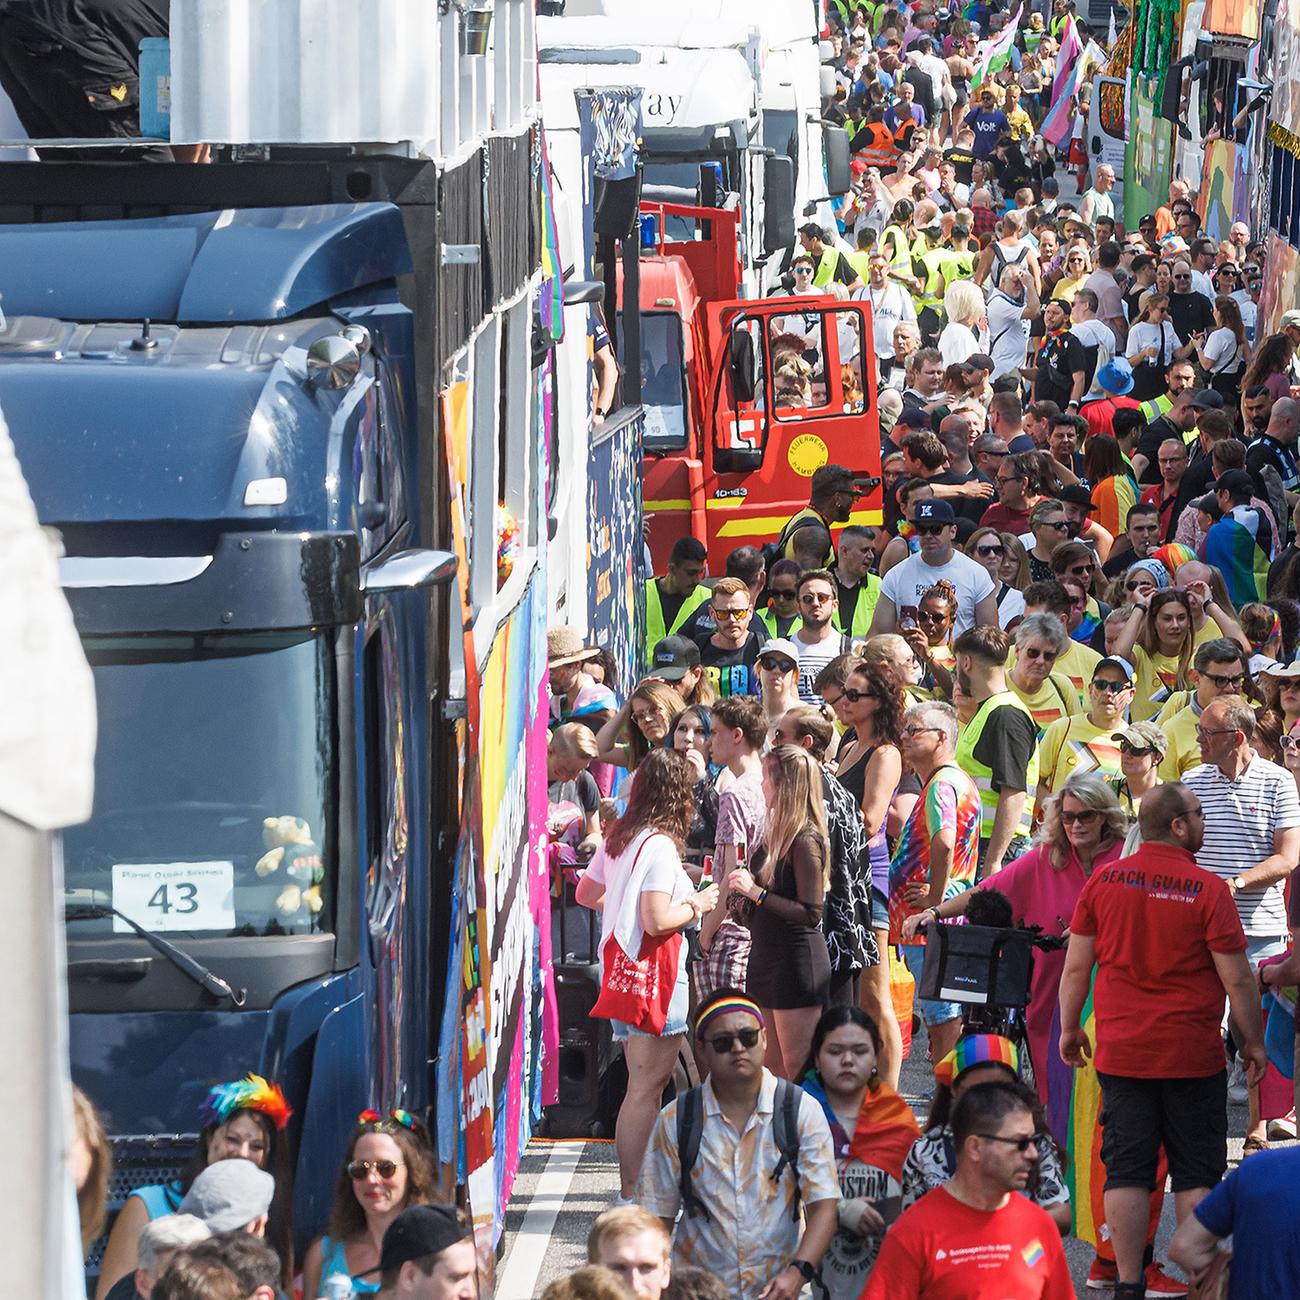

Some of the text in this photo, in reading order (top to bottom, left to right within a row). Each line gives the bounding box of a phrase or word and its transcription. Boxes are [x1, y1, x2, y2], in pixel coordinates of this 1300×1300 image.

[976, 120, 997, 132] Volt
[790, 436, 826, 455] FEUERWEHR
[792, 460, 825, 475] HAMBG
[1102, 868, 1205, 894] BEACH GUARD
[147, 882, 199, 915] 43
[838, 1170, 889, 1200] USTOM
